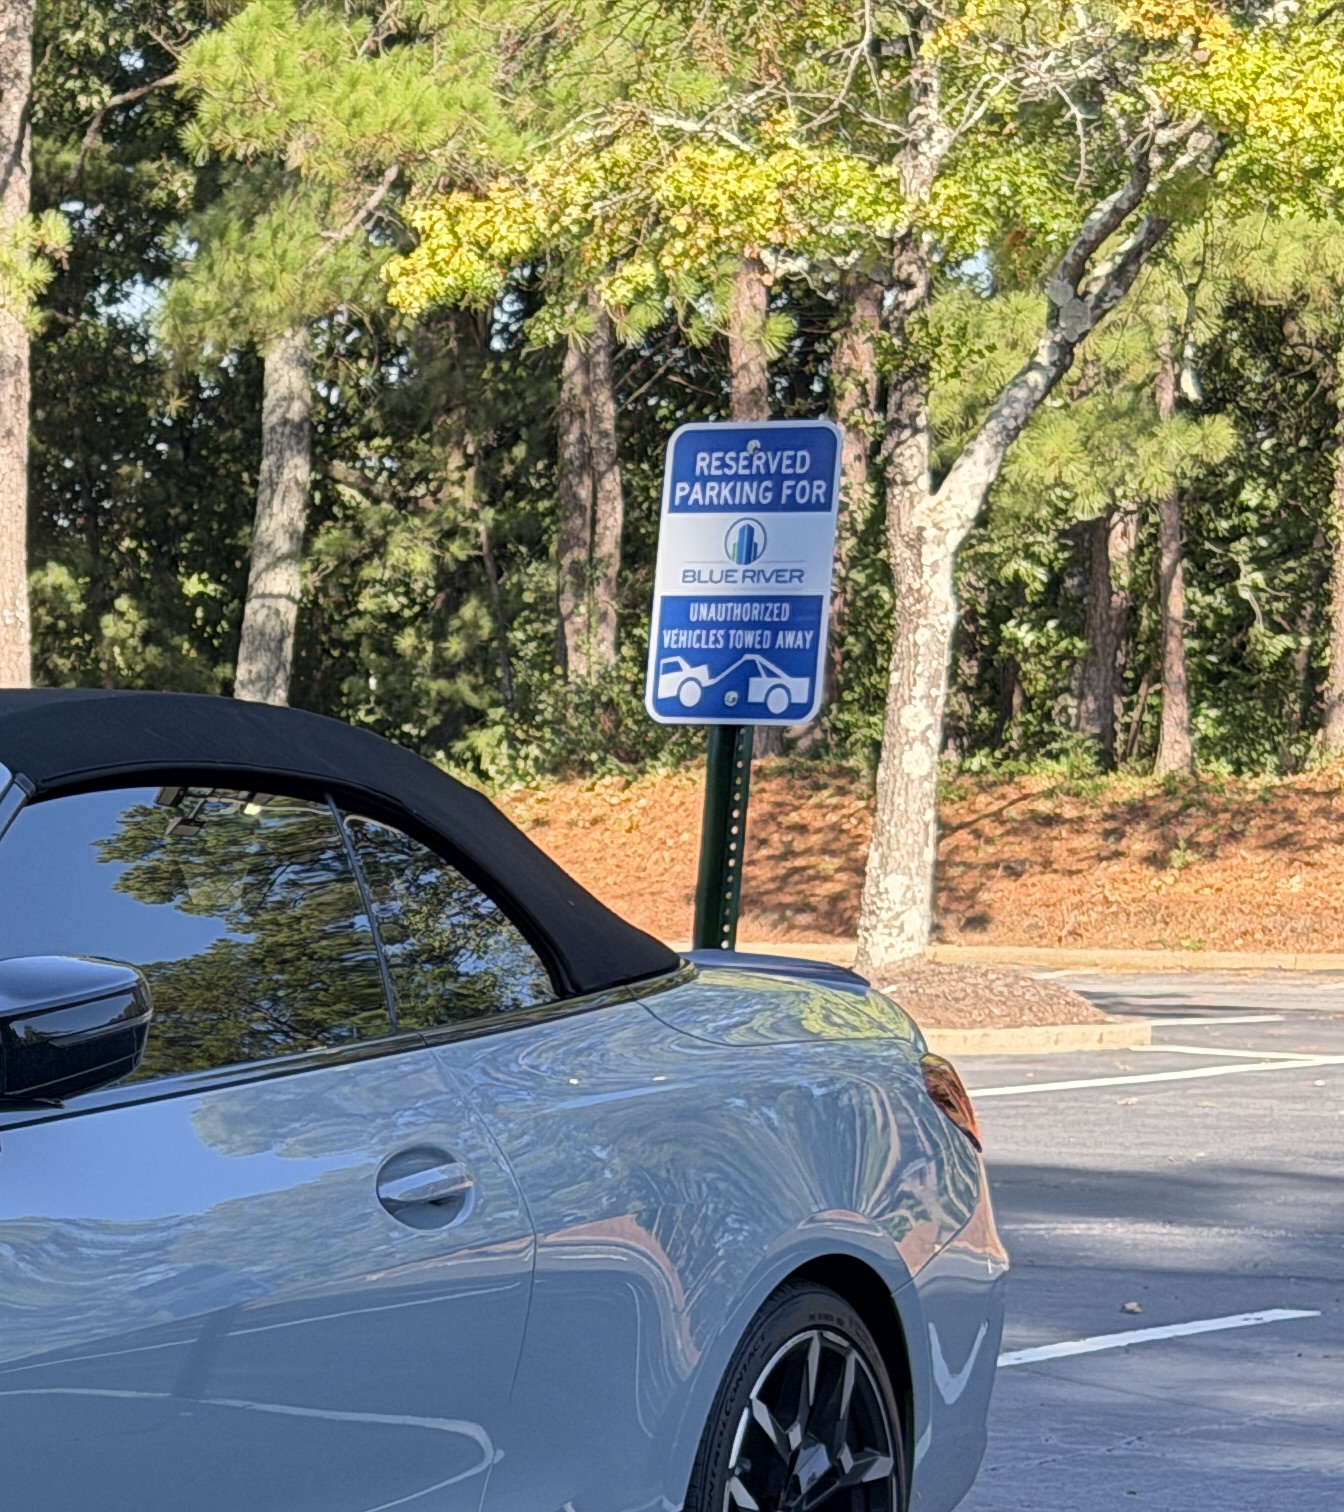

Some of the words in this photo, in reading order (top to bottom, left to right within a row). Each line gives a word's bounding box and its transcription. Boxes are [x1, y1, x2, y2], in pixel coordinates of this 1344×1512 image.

[695, 451, 810, 477] RESERVED
[674, 481, 773, 506] PARKING
[781, 480, 827, 504] FOR
[682, 569, 738, 584] BLUE
[741, 569, 805, 584] RIVER
[689, 602, 790, 622] UNAUTHORIZED
[662, 629, 725, 649] VEHICLES
[728, 629, 772, 649] TOWED
[774, 629, 814, 649] AWAY
